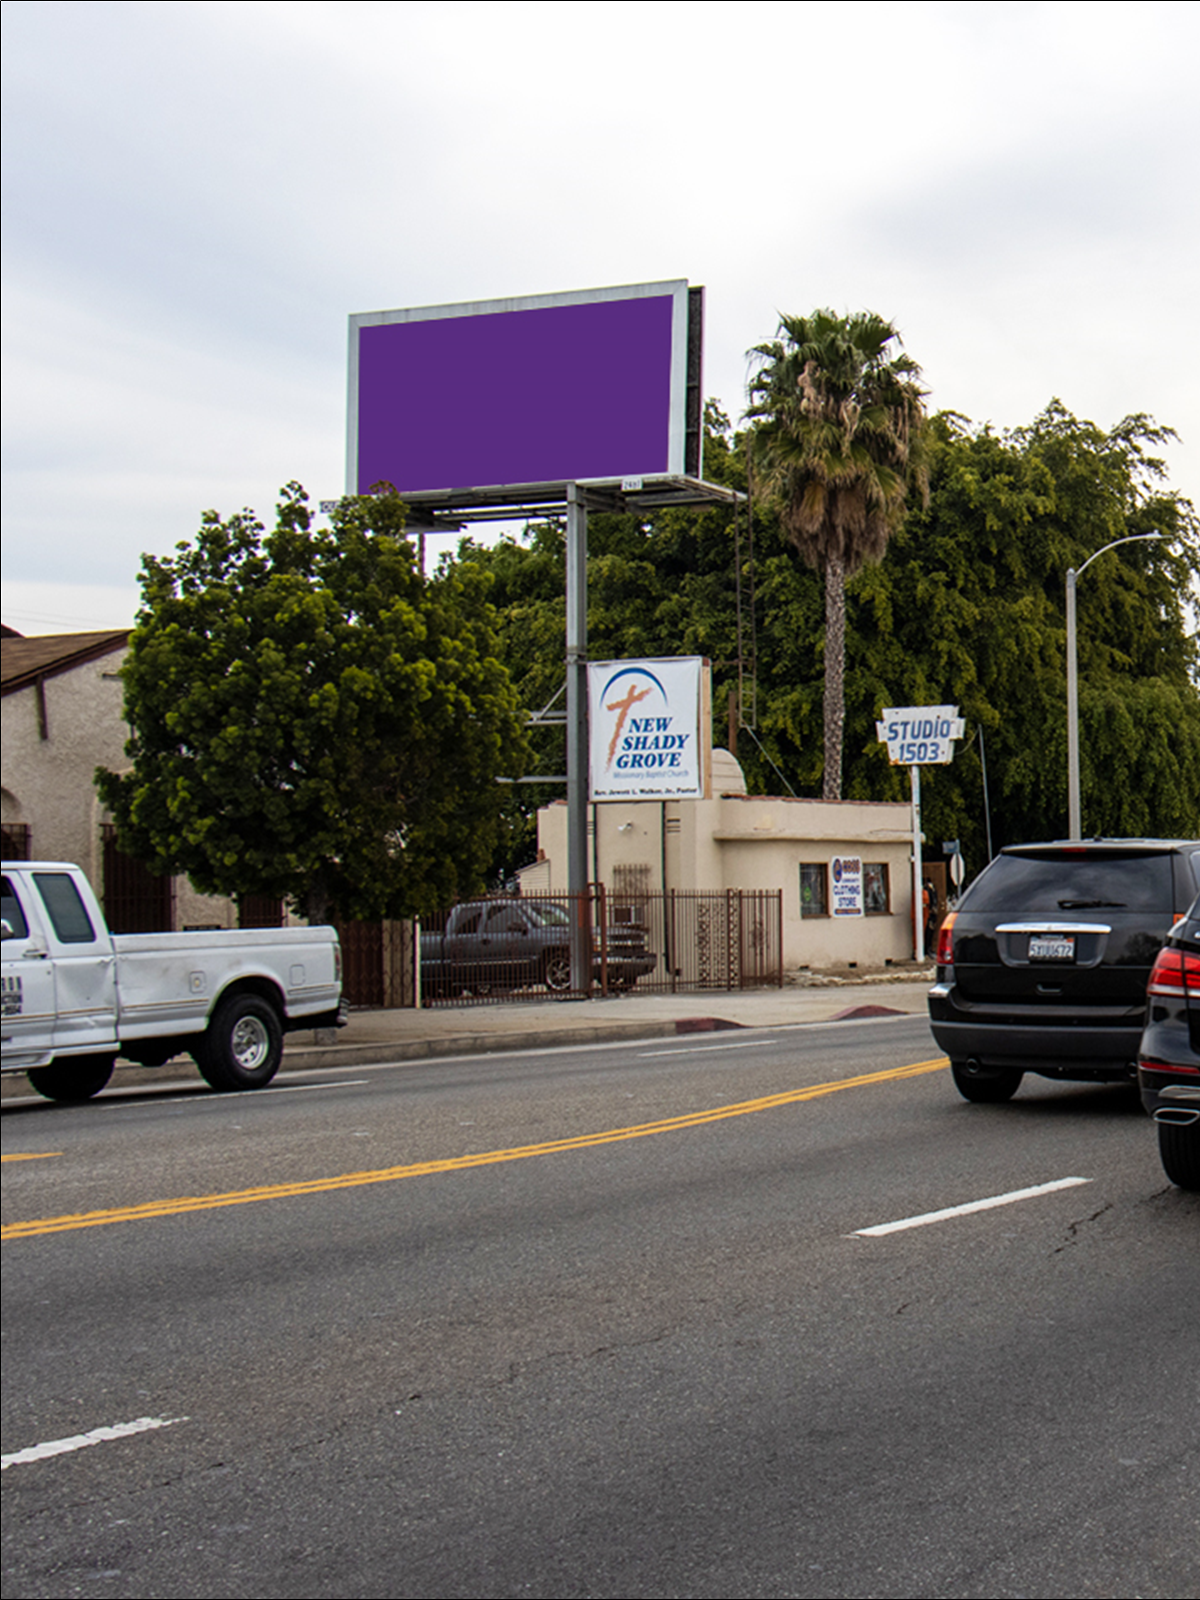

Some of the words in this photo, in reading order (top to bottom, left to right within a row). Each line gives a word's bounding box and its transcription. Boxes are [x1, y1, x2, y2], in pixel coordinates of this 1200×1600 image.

[628, 717, 673, 733] NEW
[887, 720, 951, 741] STUDIO
[622, 734, 690, 751] SHADY
[899, 742, 940, 762] 1503
[616, 752, 681, 769] GROVE
[613, 771, 644, 780] Missionary
[646, 770, 666, 778] Baptist
[667, 769, 689, 777] Church
[676, 786, 697, 794] Pastor
[833, 885, 861, 895] CLOTHING
[838, 897, 856, 907] STORE
